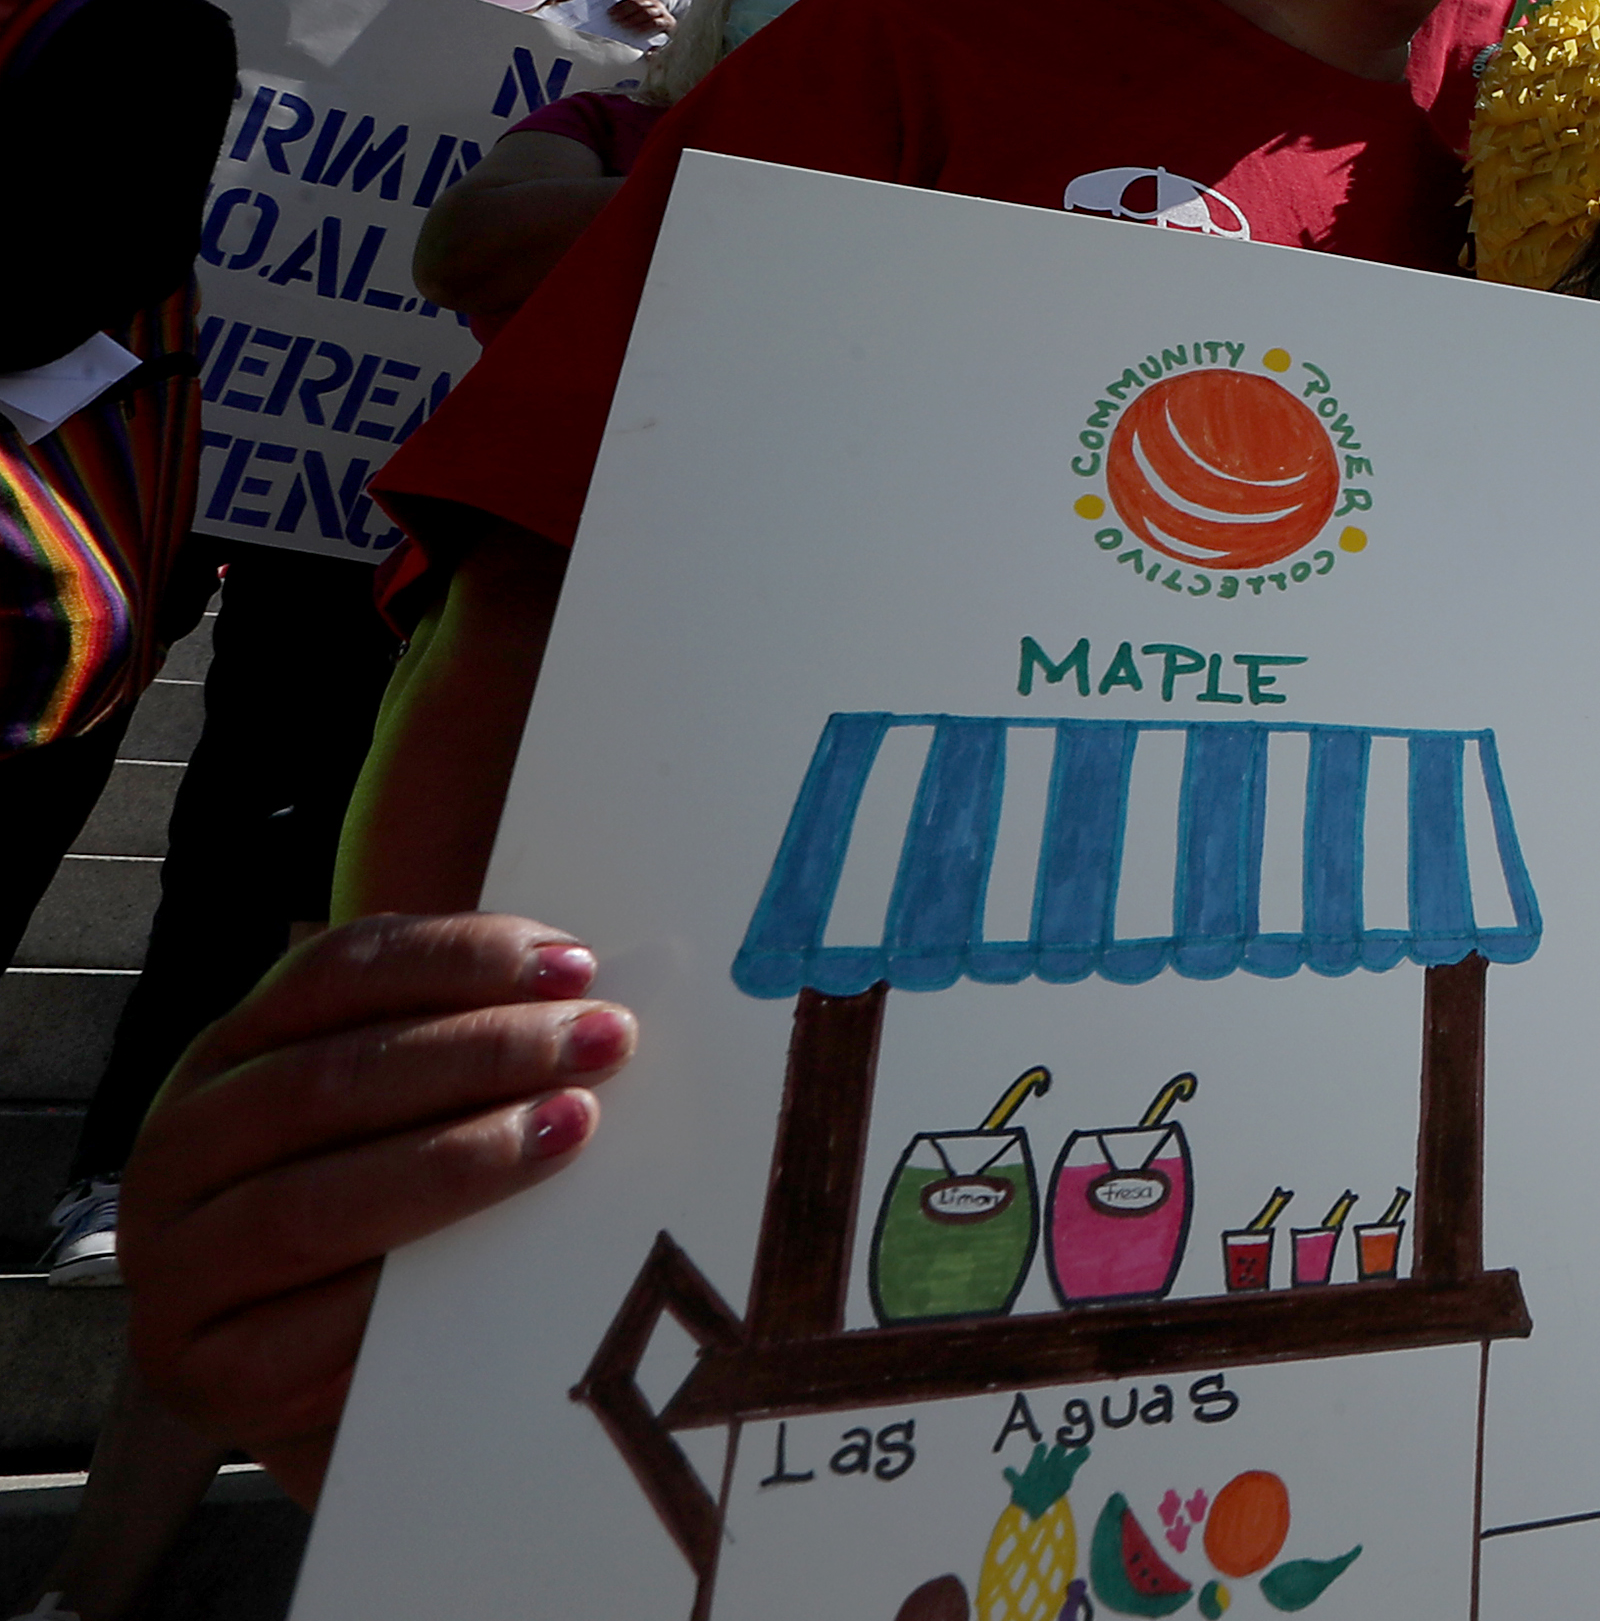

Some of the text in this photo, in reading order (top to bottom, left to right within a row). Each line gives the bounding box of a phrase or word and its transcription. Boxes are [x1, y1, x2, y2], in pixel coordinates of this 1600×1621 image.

[1071, 341, 1374, 599] COMMUNITY POWER COLLECTIVO
[1019, 637, 1308, 706] MAPLE
[759, 1373, 1240, 1488] Las Aguas
